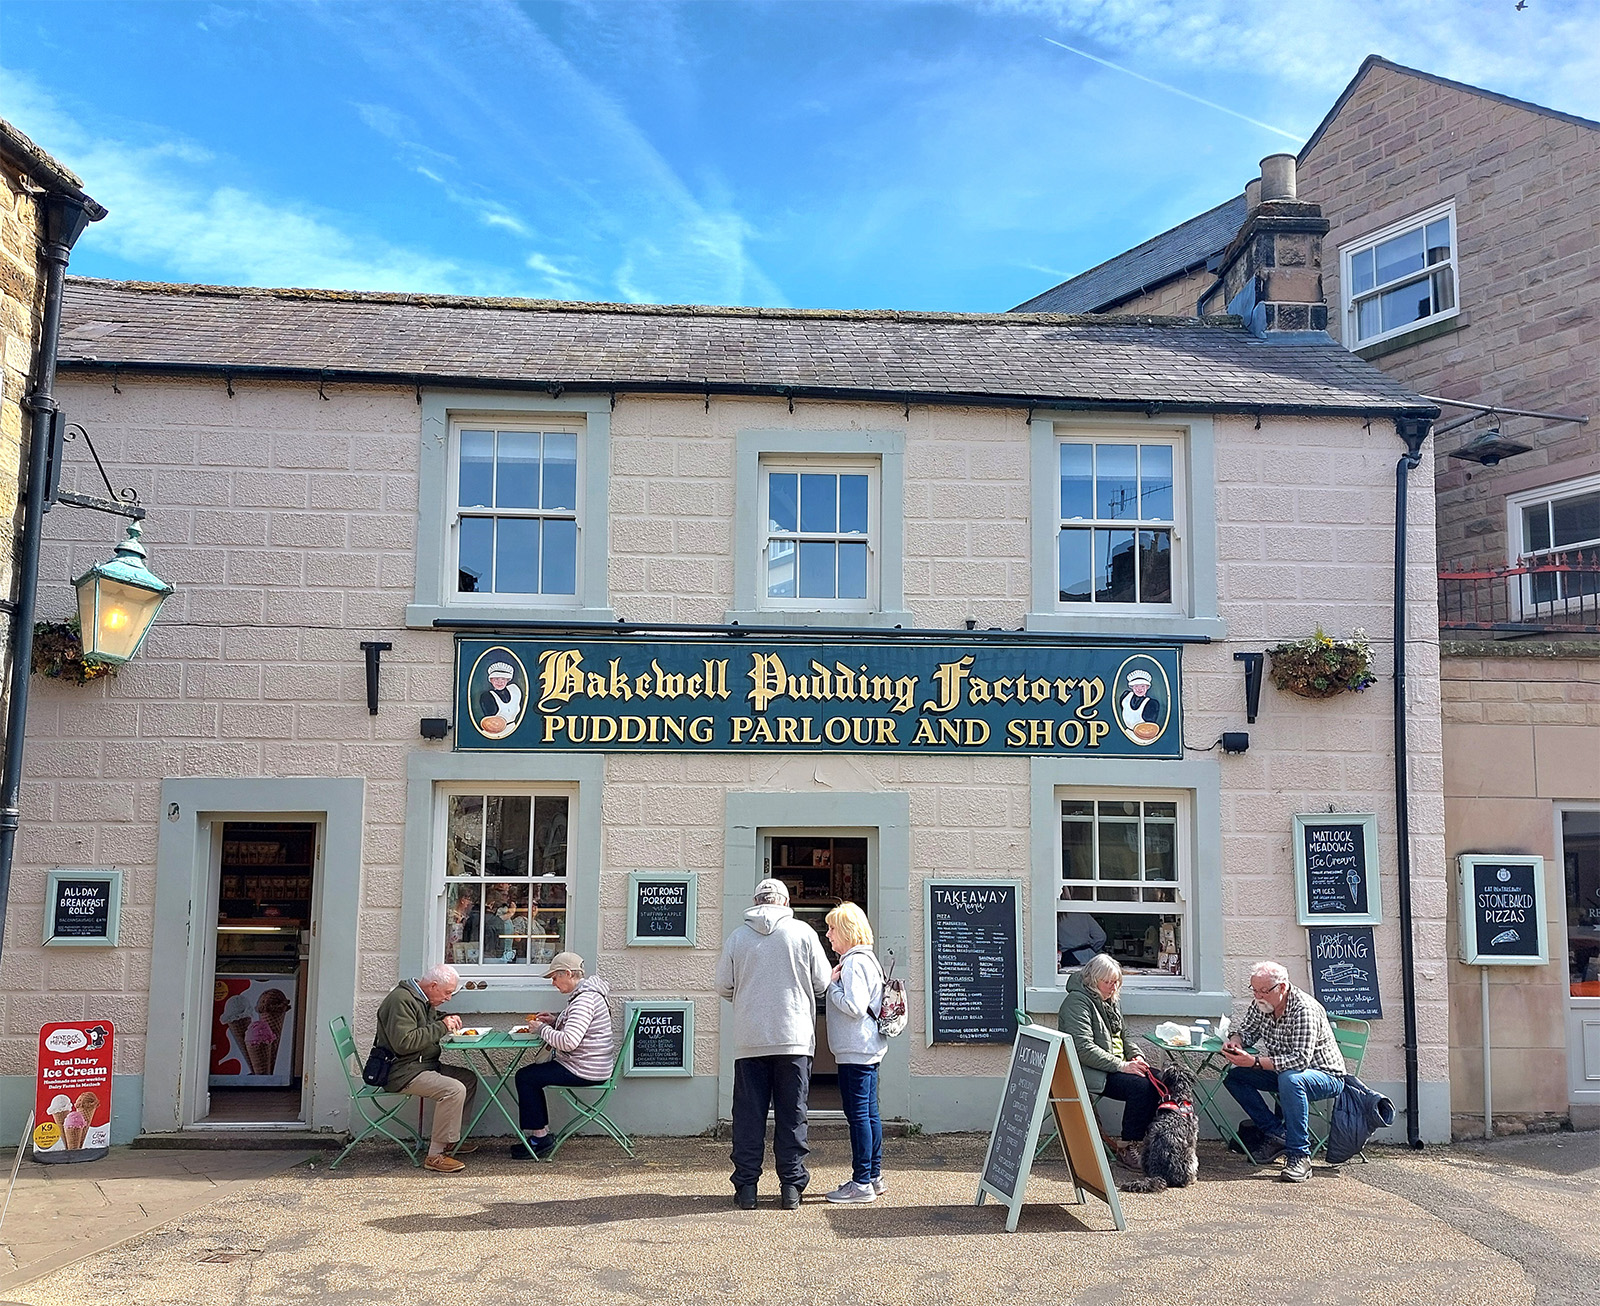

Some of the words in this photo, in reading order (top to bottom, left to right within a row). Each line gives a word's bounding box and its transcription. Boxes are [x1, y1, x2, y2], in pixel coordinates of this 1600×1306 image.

[537, 648, 732, 713] Bakewell
[747, 651, 919, 713] Pudding
[923, 655, 1106, 719] Factory
[541, 715, 715, 743] PUDDING
[731, 716, 900, 744] PARLOUR
[912, 717, 991, 745] AND
[1006, 718, 1111, 747] SHOP
[1312, 830, 1353, 842] MATLOCK
[1309, 842, 1355, 853] MEADOWS
[1309, 854, 1326, 870] Ice
[1325, 853, 1357, 868] Cream
[640, 887, 658, 896] HOT
[659, 887, 684, 896] ROAST
[934, 890, 1008, 903] TAKEAWAY
[60, 898, 106, 908] BREAKFAST
[642, 896, 665, 905] PORK
[666, 896, 684, 905] ROLL
[1478, 894, 1534, 909] STONEBAKED
[68, 907, 95, 915] ROLLS
[1485, 910, 1526, 924] PIZZAS
[1316, 944, 1368, 959] PUDDING
[639, 1017, 673, 1025] JACKET
[638, 1026, 682, 1034] POTATOES
[54, 1058, 73, 1066] Real
[74, 1057, 98, 1066] Dairy
[43, 1068, 62, 1078] Ice
[64, 1066, 108, 1077] Cream
[41, 1124, 53, 1132] K9
